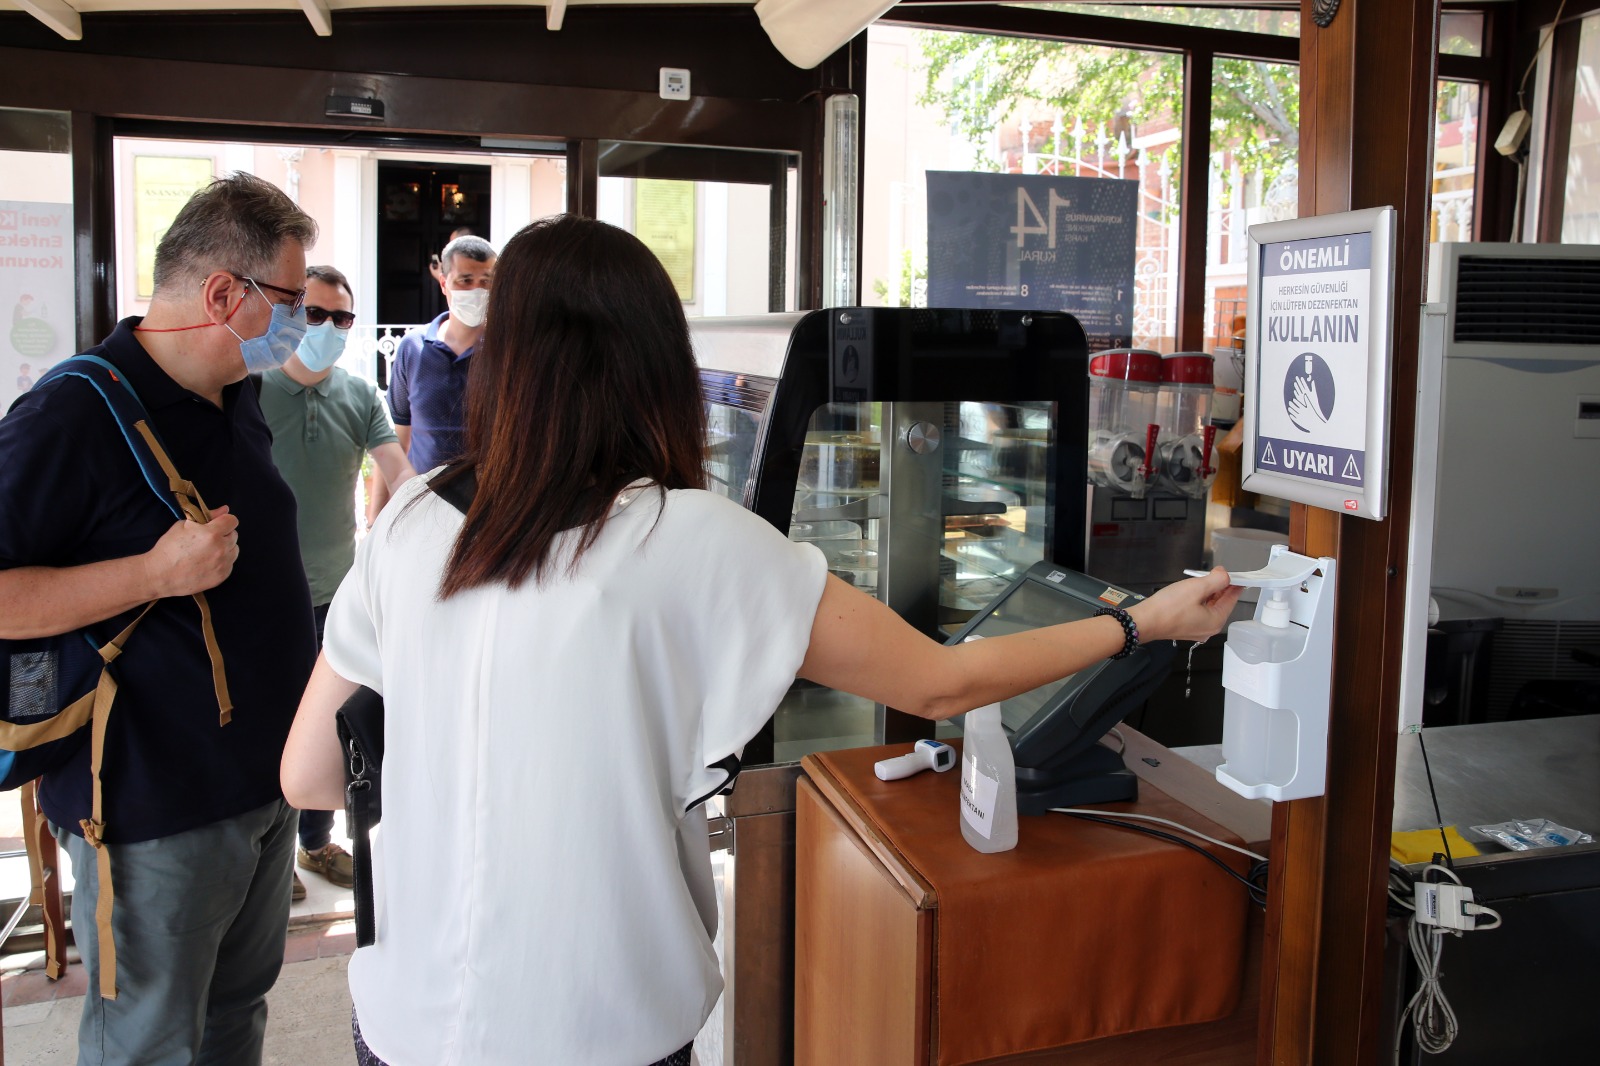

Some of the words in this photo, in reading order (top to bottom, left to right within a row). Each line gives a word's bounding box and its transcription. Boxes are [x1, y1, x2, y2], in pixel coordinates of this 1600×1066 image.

[1279, 239, 1350, 272] ÖNEMLİ
[1278, 283, 1310, 296] HERKESİN
[1310, 280, 1348, 295] GÜVENLİĞİ
[1270, 299, 1283, 313] İÇİN
[1283, 299, 1308, 311] LÜTFEN
[1307, 298, 1359, 310] DEZENFEKTAN
[1268, 314, 1359, 343] KULLANIN
[1283, 449, 1335, 476] UYARI
